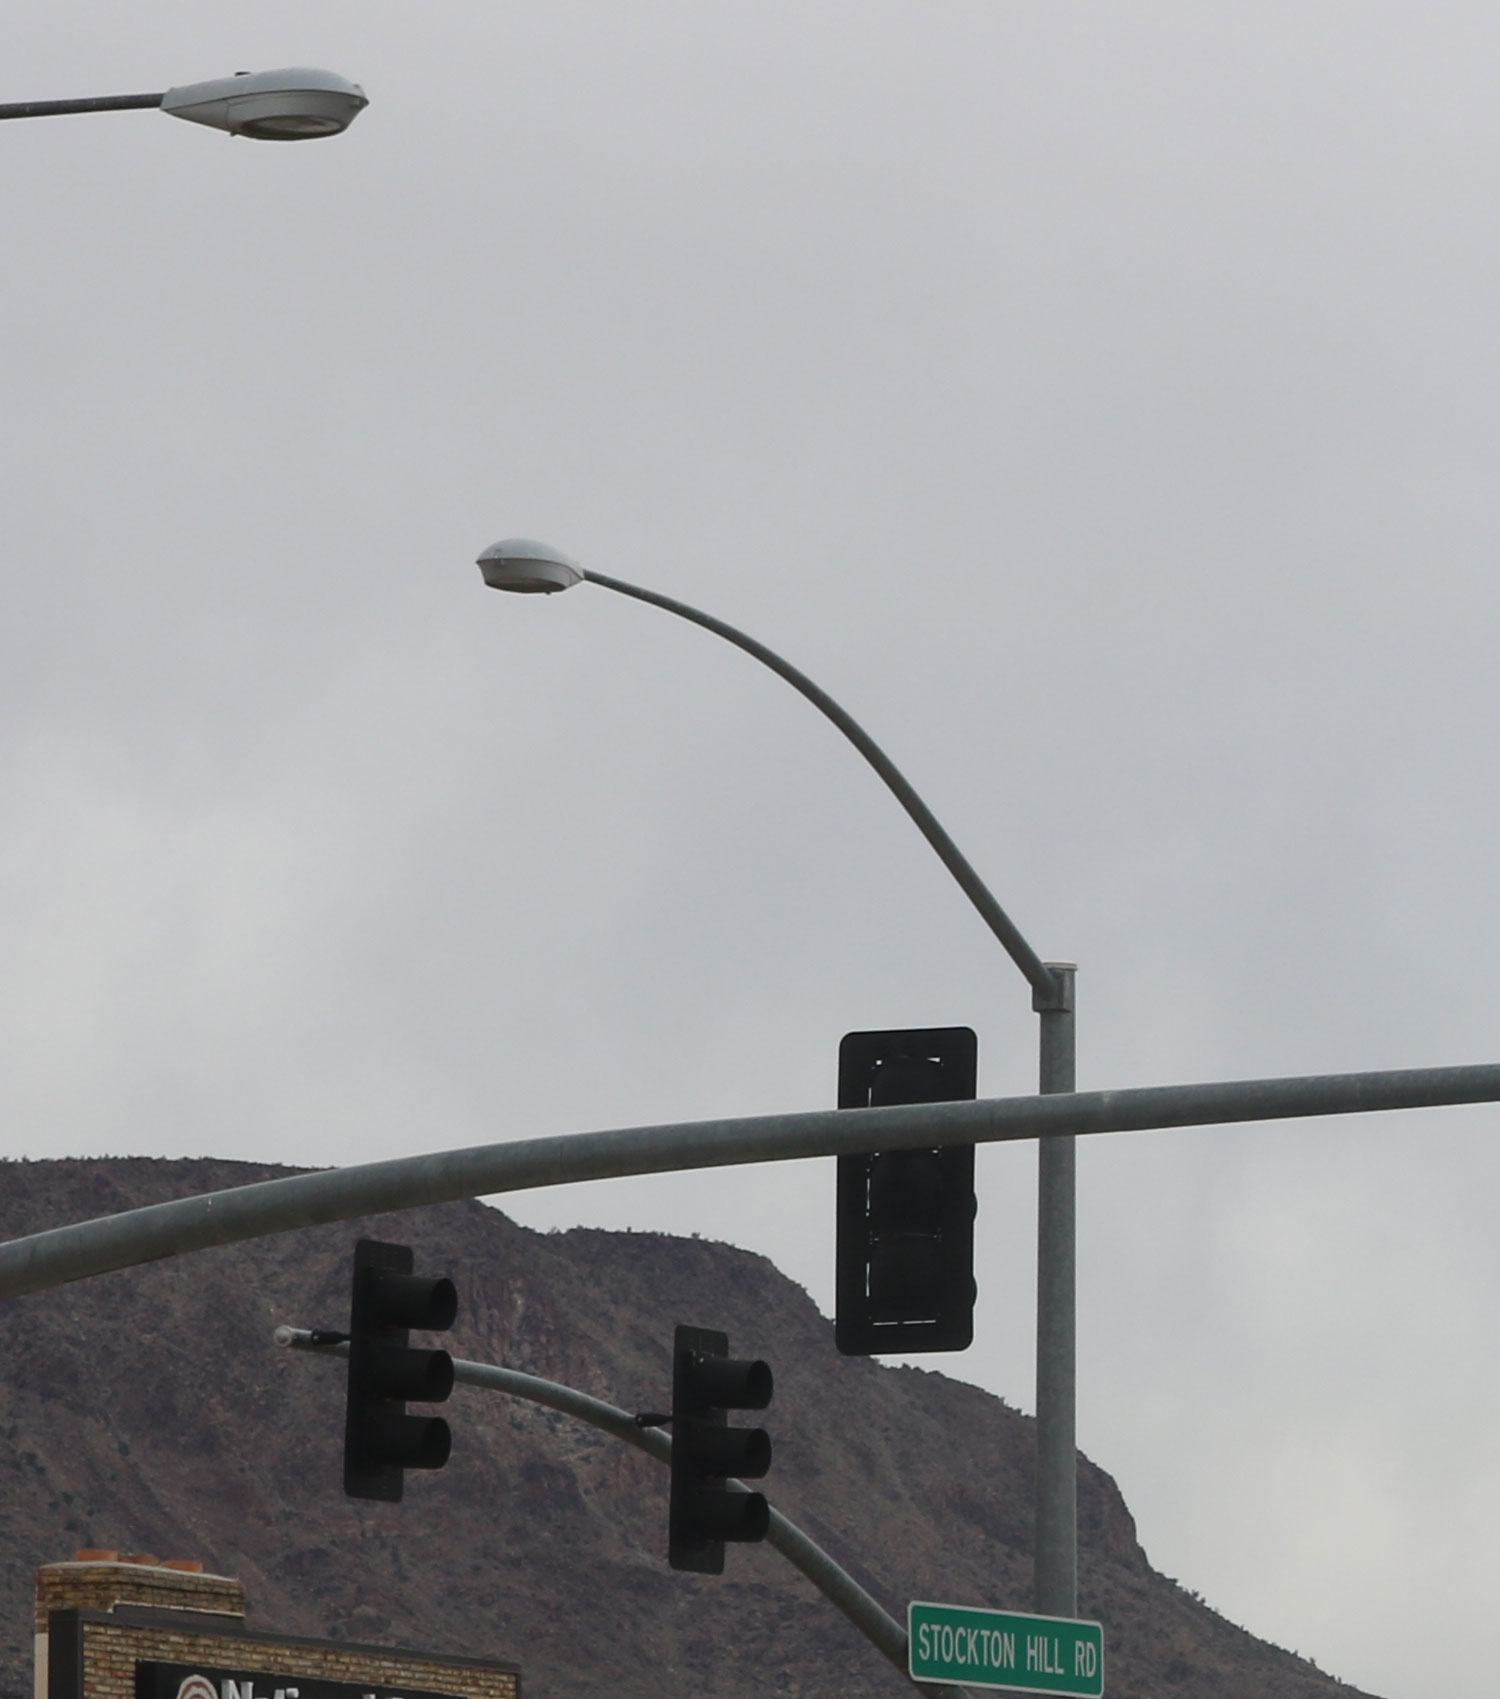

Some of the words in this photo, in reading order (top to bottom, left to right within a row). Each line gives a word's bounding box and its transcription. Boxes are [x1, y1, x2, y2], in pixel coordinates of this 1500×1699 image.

[919, 1623, 1015, 1669] STOCKTON
[1027, 1635, 1064, 1675] HILL
[1075, 1640, 1096, 1678] RD
